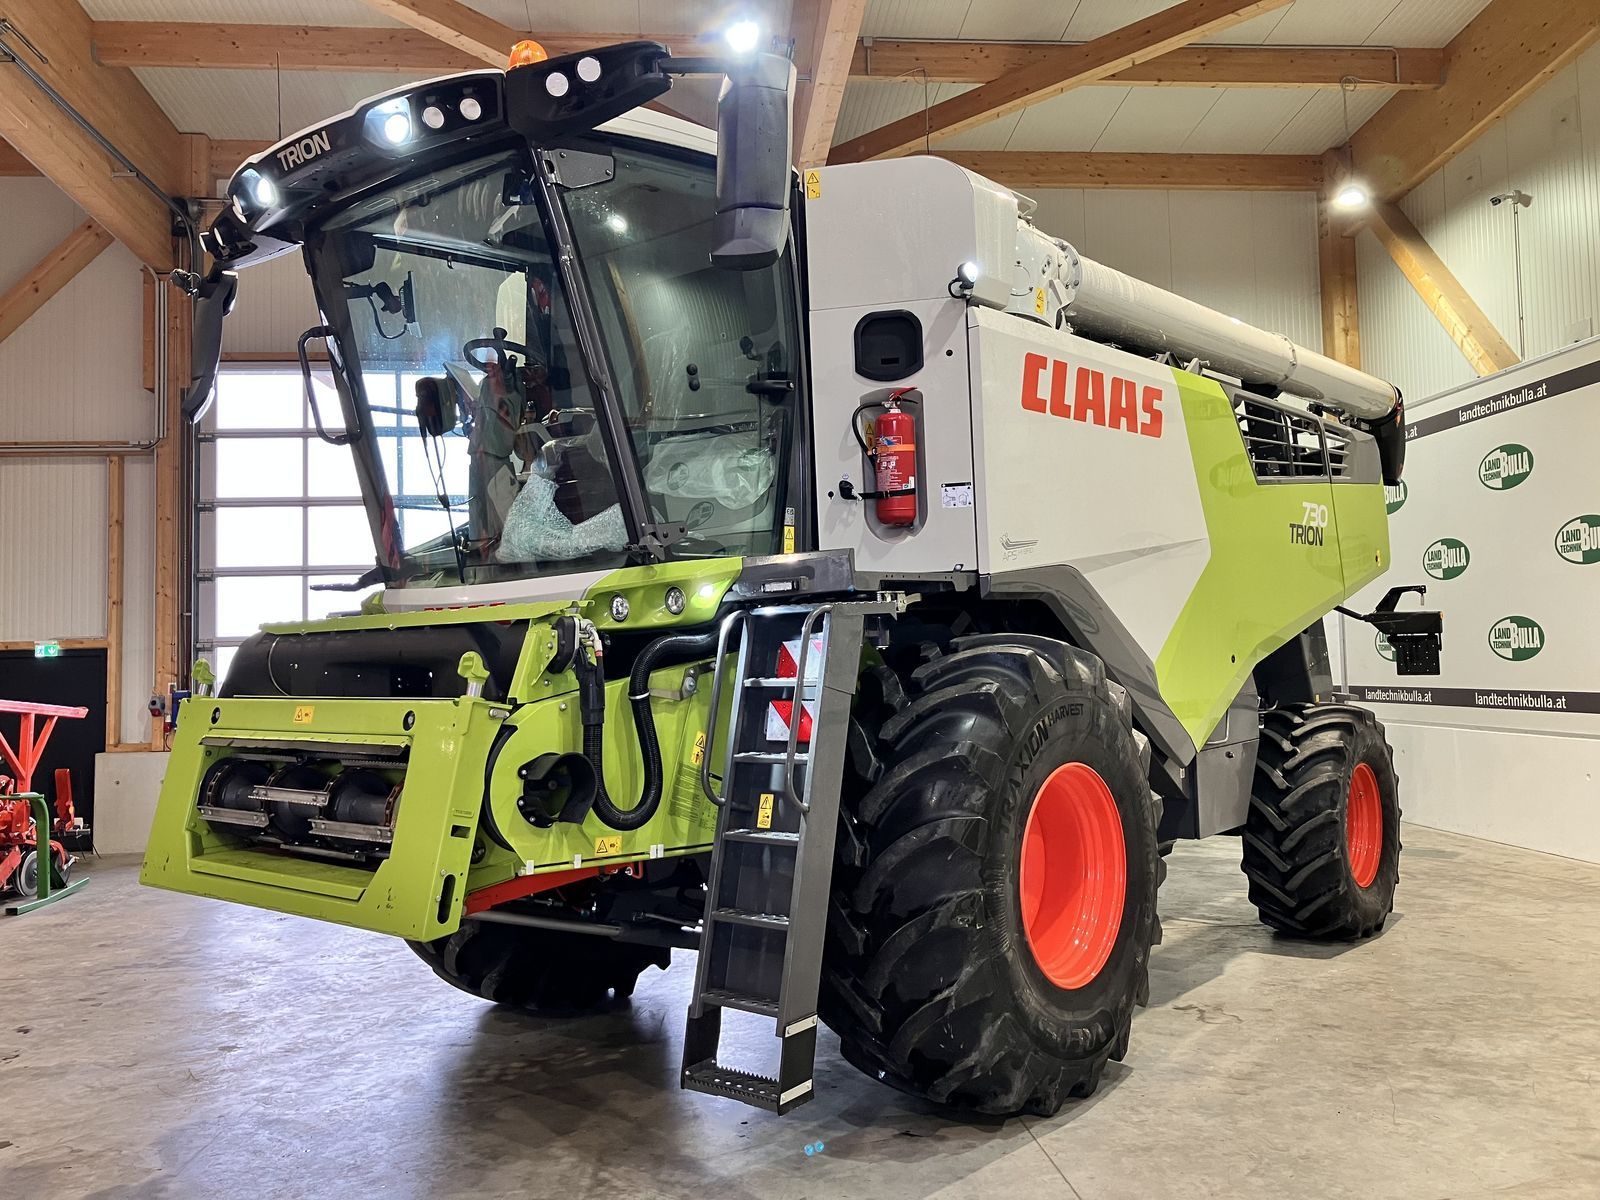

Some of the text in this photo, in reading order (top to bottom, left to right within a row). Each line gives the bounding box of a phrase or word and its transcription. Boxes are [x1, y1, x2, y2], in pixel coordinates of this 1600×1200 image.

[277, 131, 331, 171] TRION
[1021, 352, 1163, 438] CLAAS
[1459, 382, 1547, 422] landtechnikbulla.at
[1485, 458, 1500, 472] LAND
[1500, 451, 1530, 478] BULLA
[1302, 501, 1328, 528] 730
[1289, 523, 1324, 546] TRION
[1562, 529, 1581, 543] LAND
[1428, 550, 1441, 562] LAND
[1441, 545, 1467, 568] BULLA
[1560, 543, 1582, 553] TECHNIK
[1494, 628, 1511, 640] LAND
[1510, 622, 1540, 648] BULLA
[1365, 688, 1432, 703] landtechnikbulla.at
[1475, 692, 1567, 709] landtechnikbulla.at
[1047, 703, 1084, 727] HARVEST
